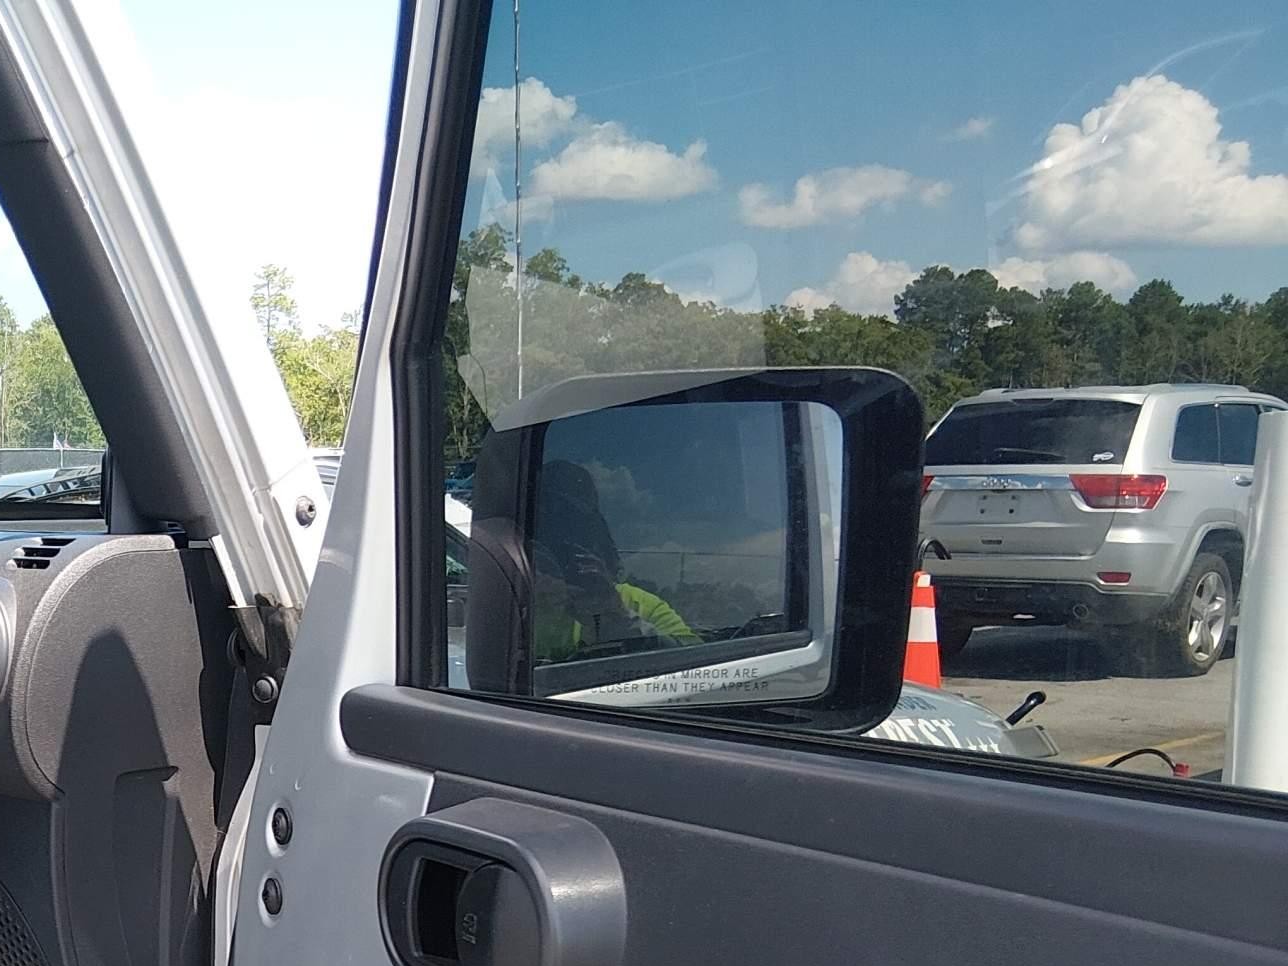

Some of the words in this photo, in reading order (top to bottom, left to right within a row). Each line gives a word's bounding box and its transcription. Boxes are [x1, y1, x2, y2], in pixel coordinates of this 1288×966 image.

[681, 668, 728, 679] MIRROR
[734, 668, 759, 678] ARE
[644, 682, 678, 692] THAN
[682, 682, 714, 692] THEY
[720, 681, 769, 691] APPEAR
